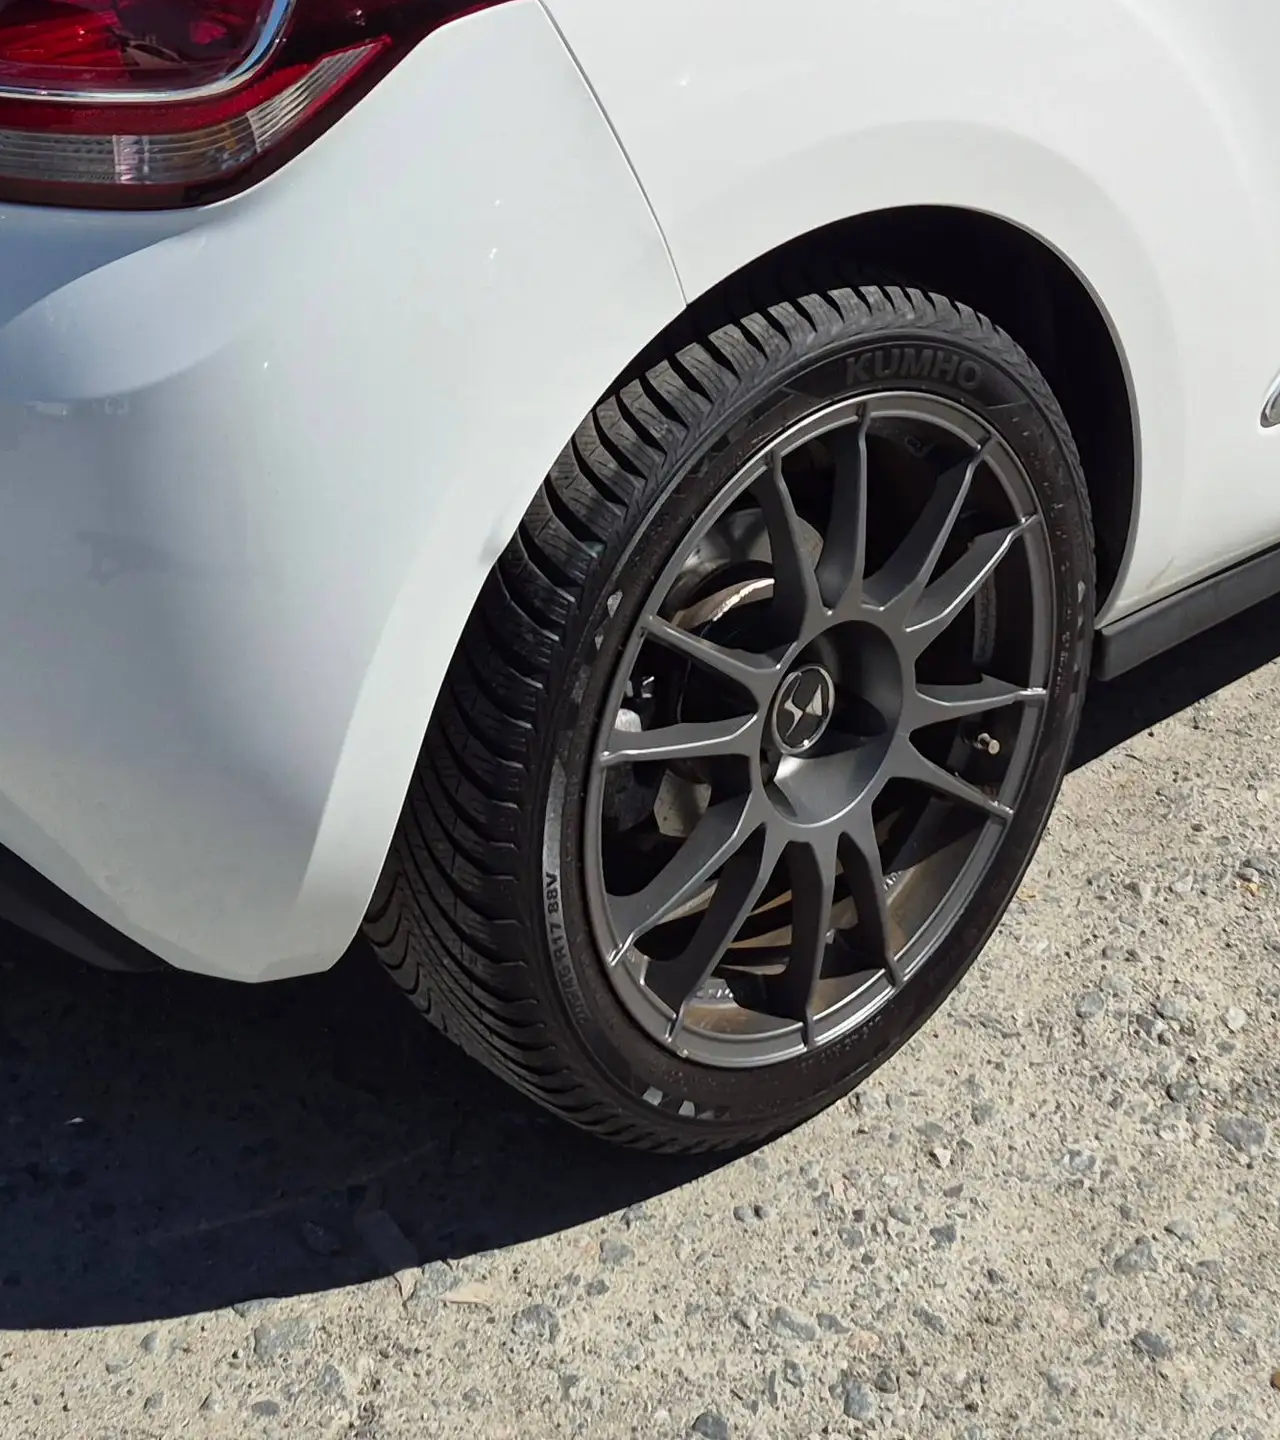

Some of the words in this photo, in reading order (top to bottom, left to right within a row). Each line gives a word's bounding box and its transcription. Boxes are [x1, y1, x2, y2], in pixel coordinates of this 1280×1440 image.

[847, 348, 982, 389] KUMHO
[546, 872, 558, 914] 88V
[550, 924, 566, 961] R17
